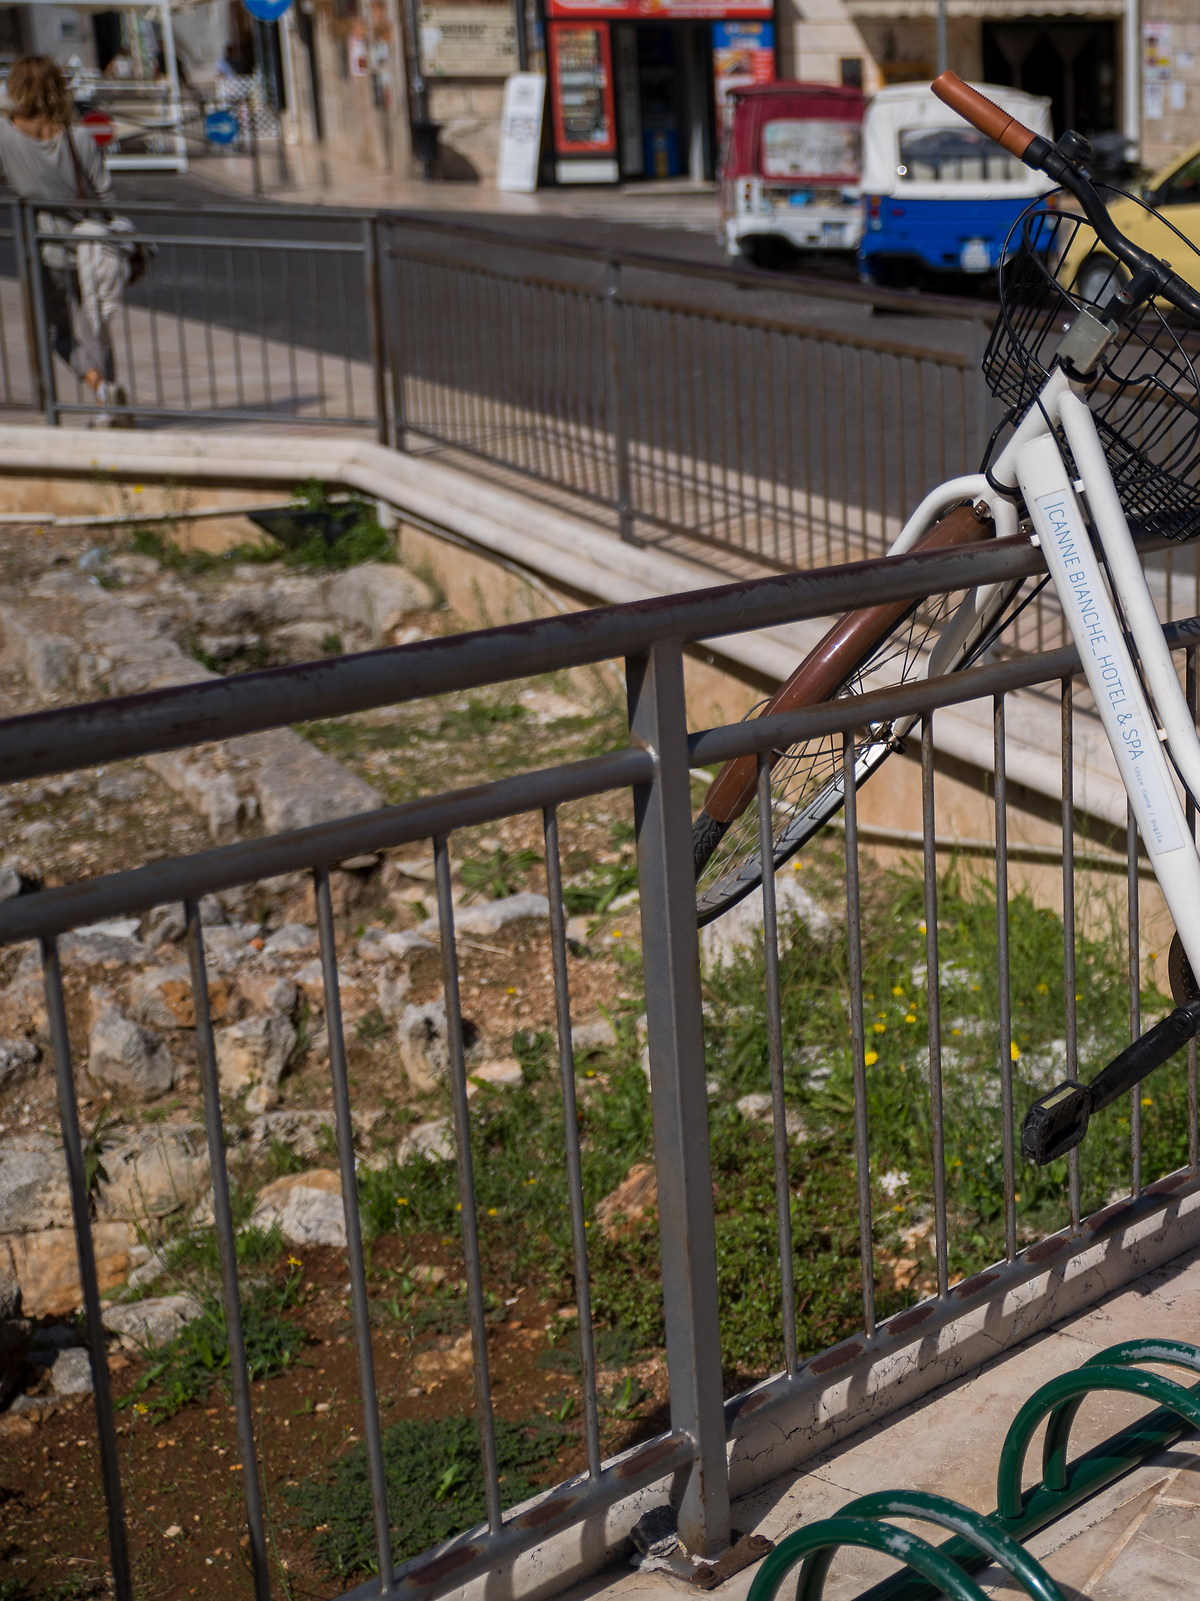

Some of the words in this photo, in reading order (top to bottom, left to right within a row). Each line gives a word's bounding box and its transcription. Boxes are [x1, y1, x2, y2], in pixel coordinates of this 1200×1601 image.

[1115, 712, 1133, 727] &
[1121, 728, 1145, 761] SPA
[1133, 765, 1144, 786] torre
[1140, 788, 1152, 809] canne
